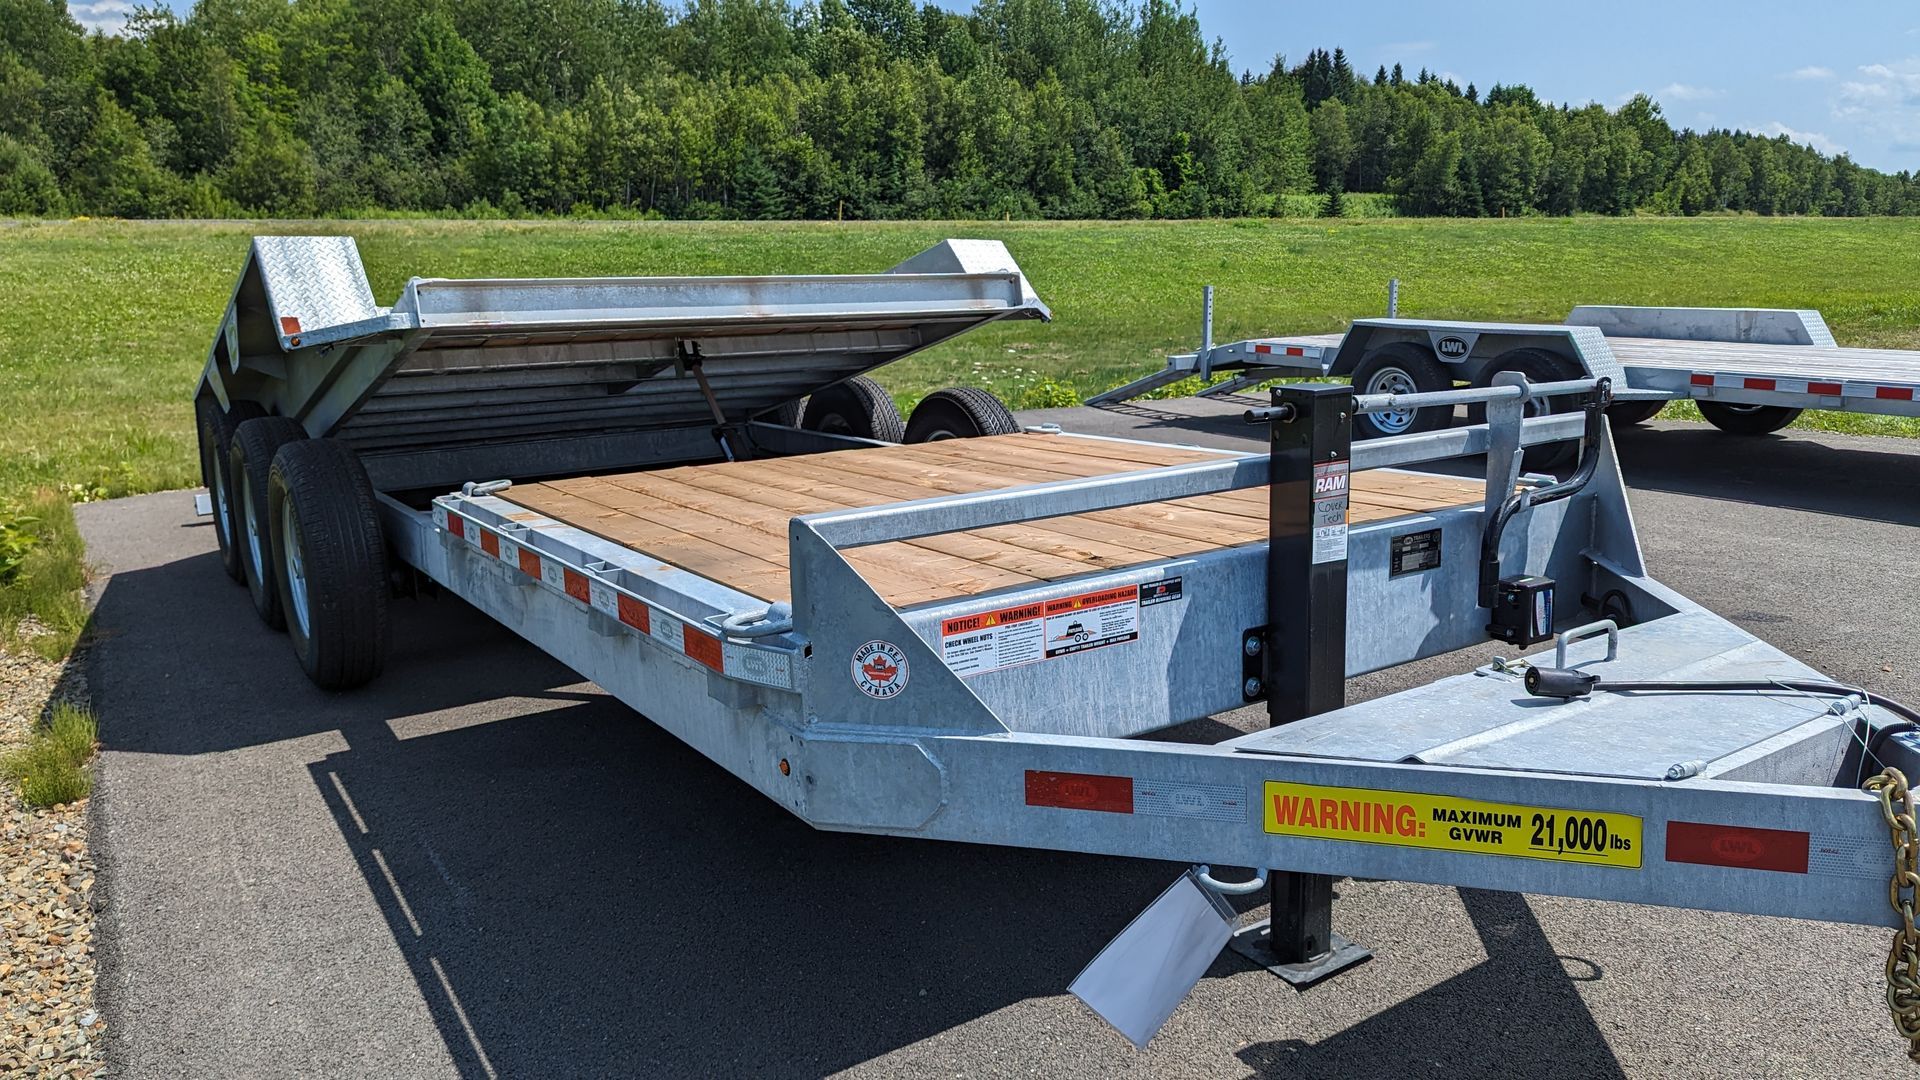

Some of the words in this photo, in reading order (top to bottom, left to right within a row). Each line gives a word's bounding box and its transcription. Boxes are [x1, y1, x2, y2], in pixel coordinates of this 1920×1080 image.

[1441, 341, 1465, 353] LWL
[1315, 475, 1346, 494] RAM
[947, 617, 980, 634] NOTICE!
[999, 605, 1041, 623] WARNING!
[944, 639, 962, 649] CHECK
[962, 635, 979, 645] WHEEL
[979, 632, 993, 642] NUTS
[856, 644, 876, 663] MADE
[877, 643, 886, 652] IN
[860, 680, 901, 696] CANADA
[1273, 794, 1426, 838] WARNING:
[1432, 808, 1522, 829] MAXIMUM
[1449, 827, 1503, 845] GVWR
[1530, 813, 1608, 855] 21,000
[1610, 834, 1631, 851] lbs
